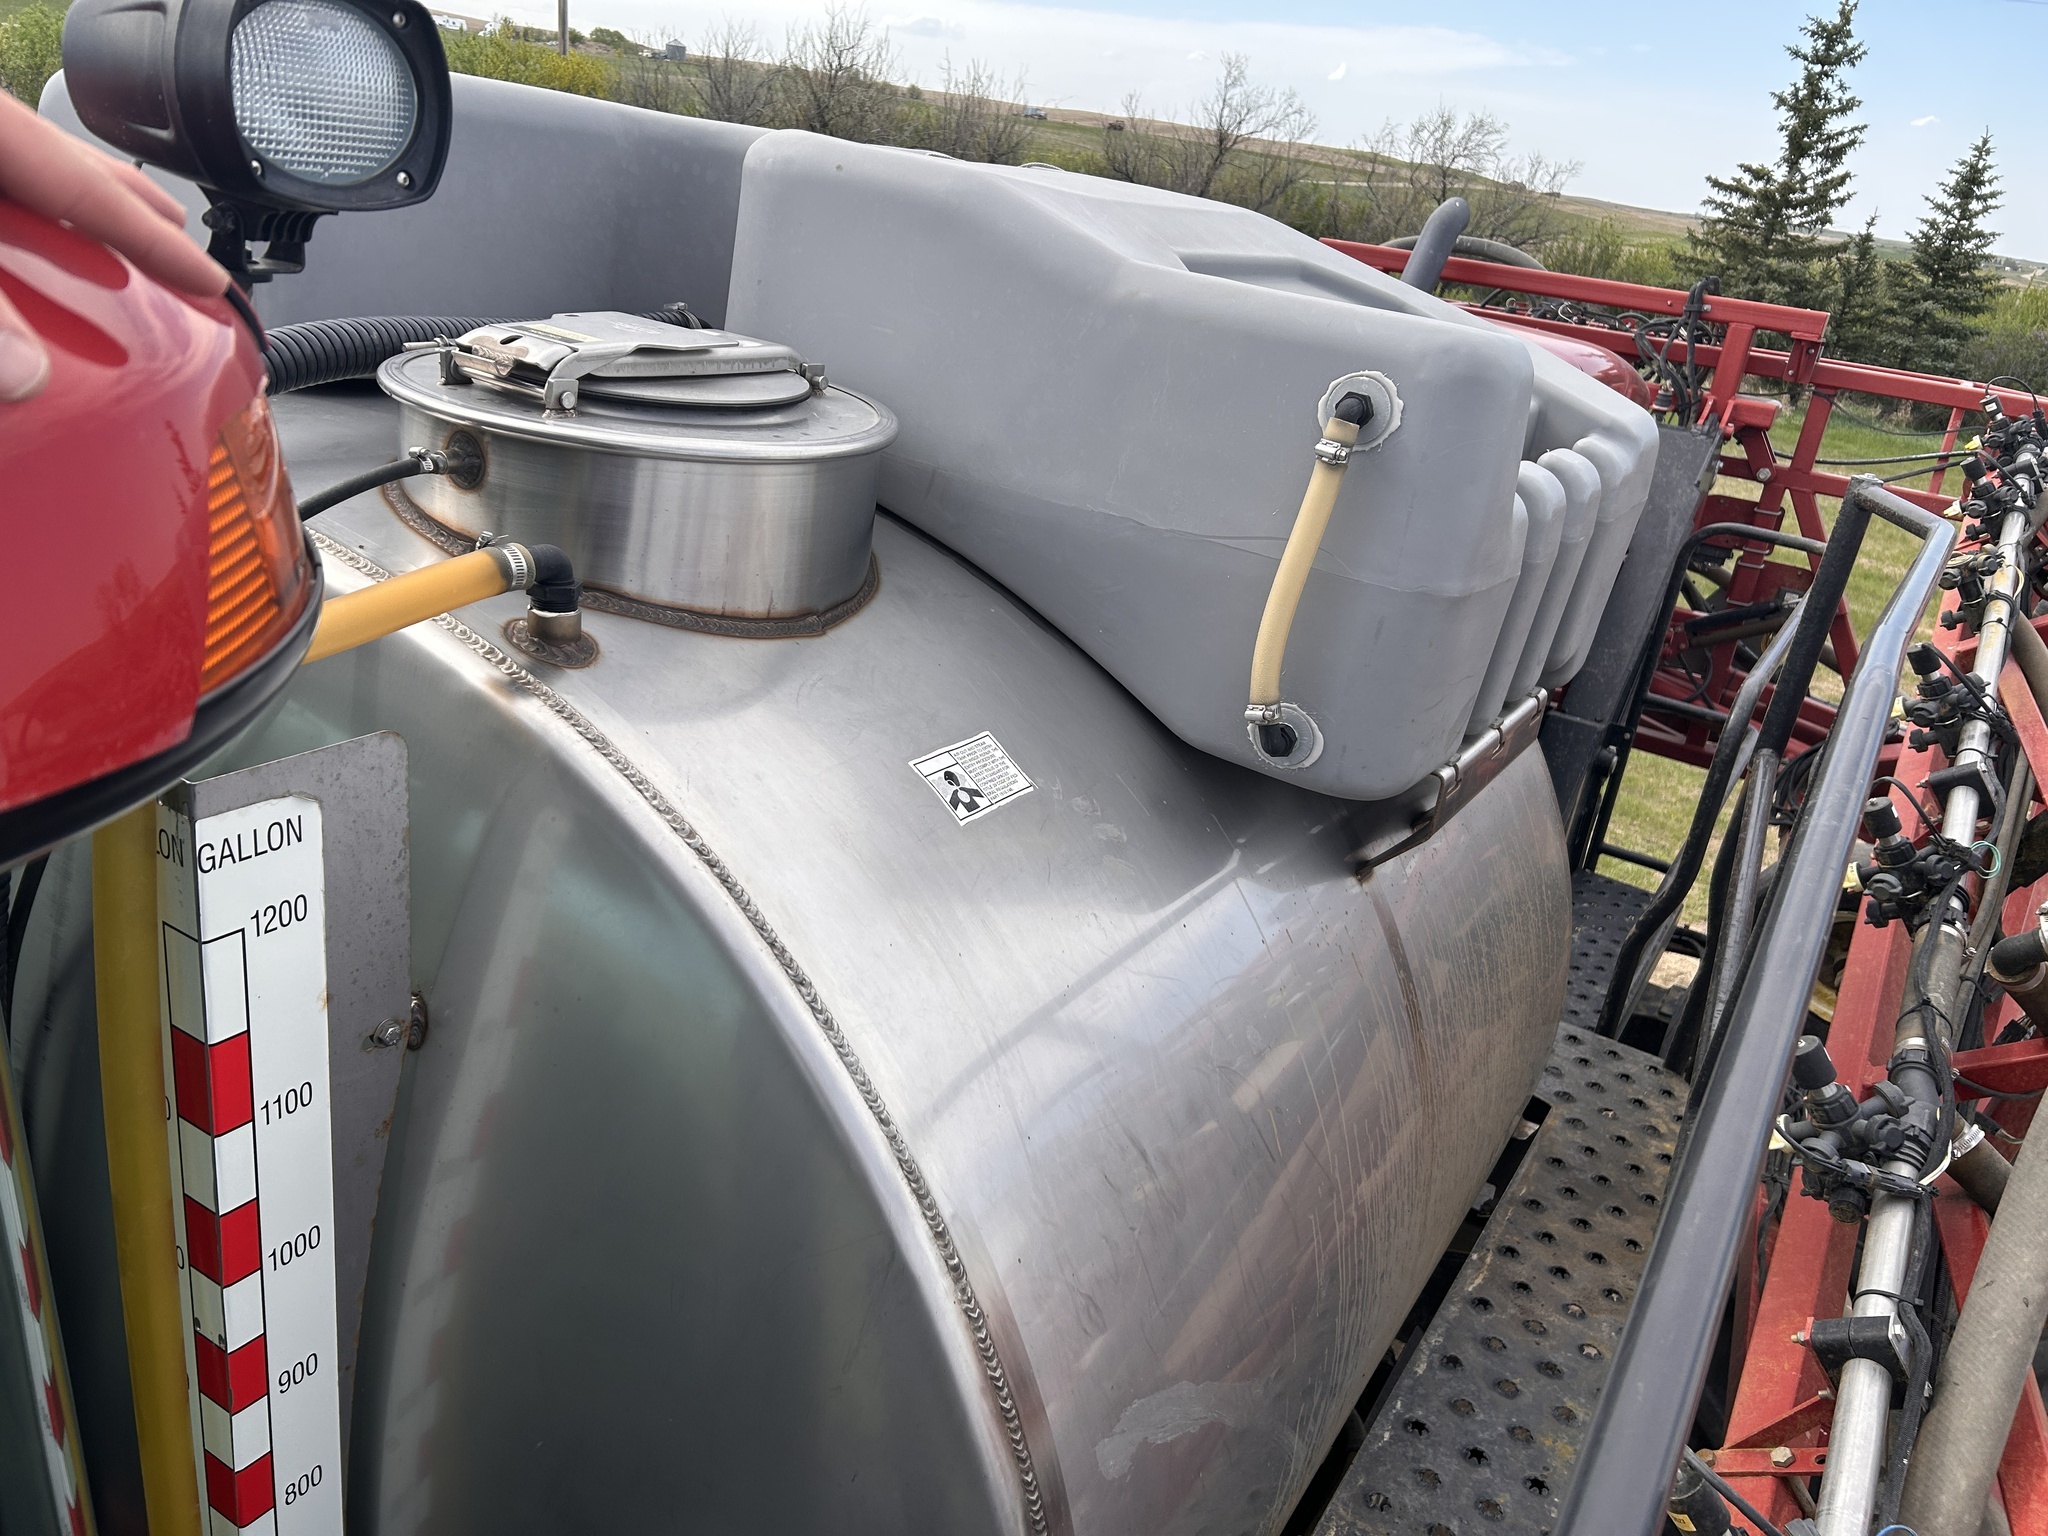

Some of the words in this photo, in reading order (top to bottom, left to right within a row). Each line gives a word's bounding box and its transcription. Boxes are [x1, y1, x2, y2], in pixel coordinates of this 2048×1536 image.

[197, 815, 302, 874] GALLON
[250, 894, 308, 937] 1200
[260, 1081, 313, 1126] 1100
[267, 1225, 321, 1271] 1000
[278, 1353, 318, 1394] 900
[284, 1465, 322, 1506] 800
